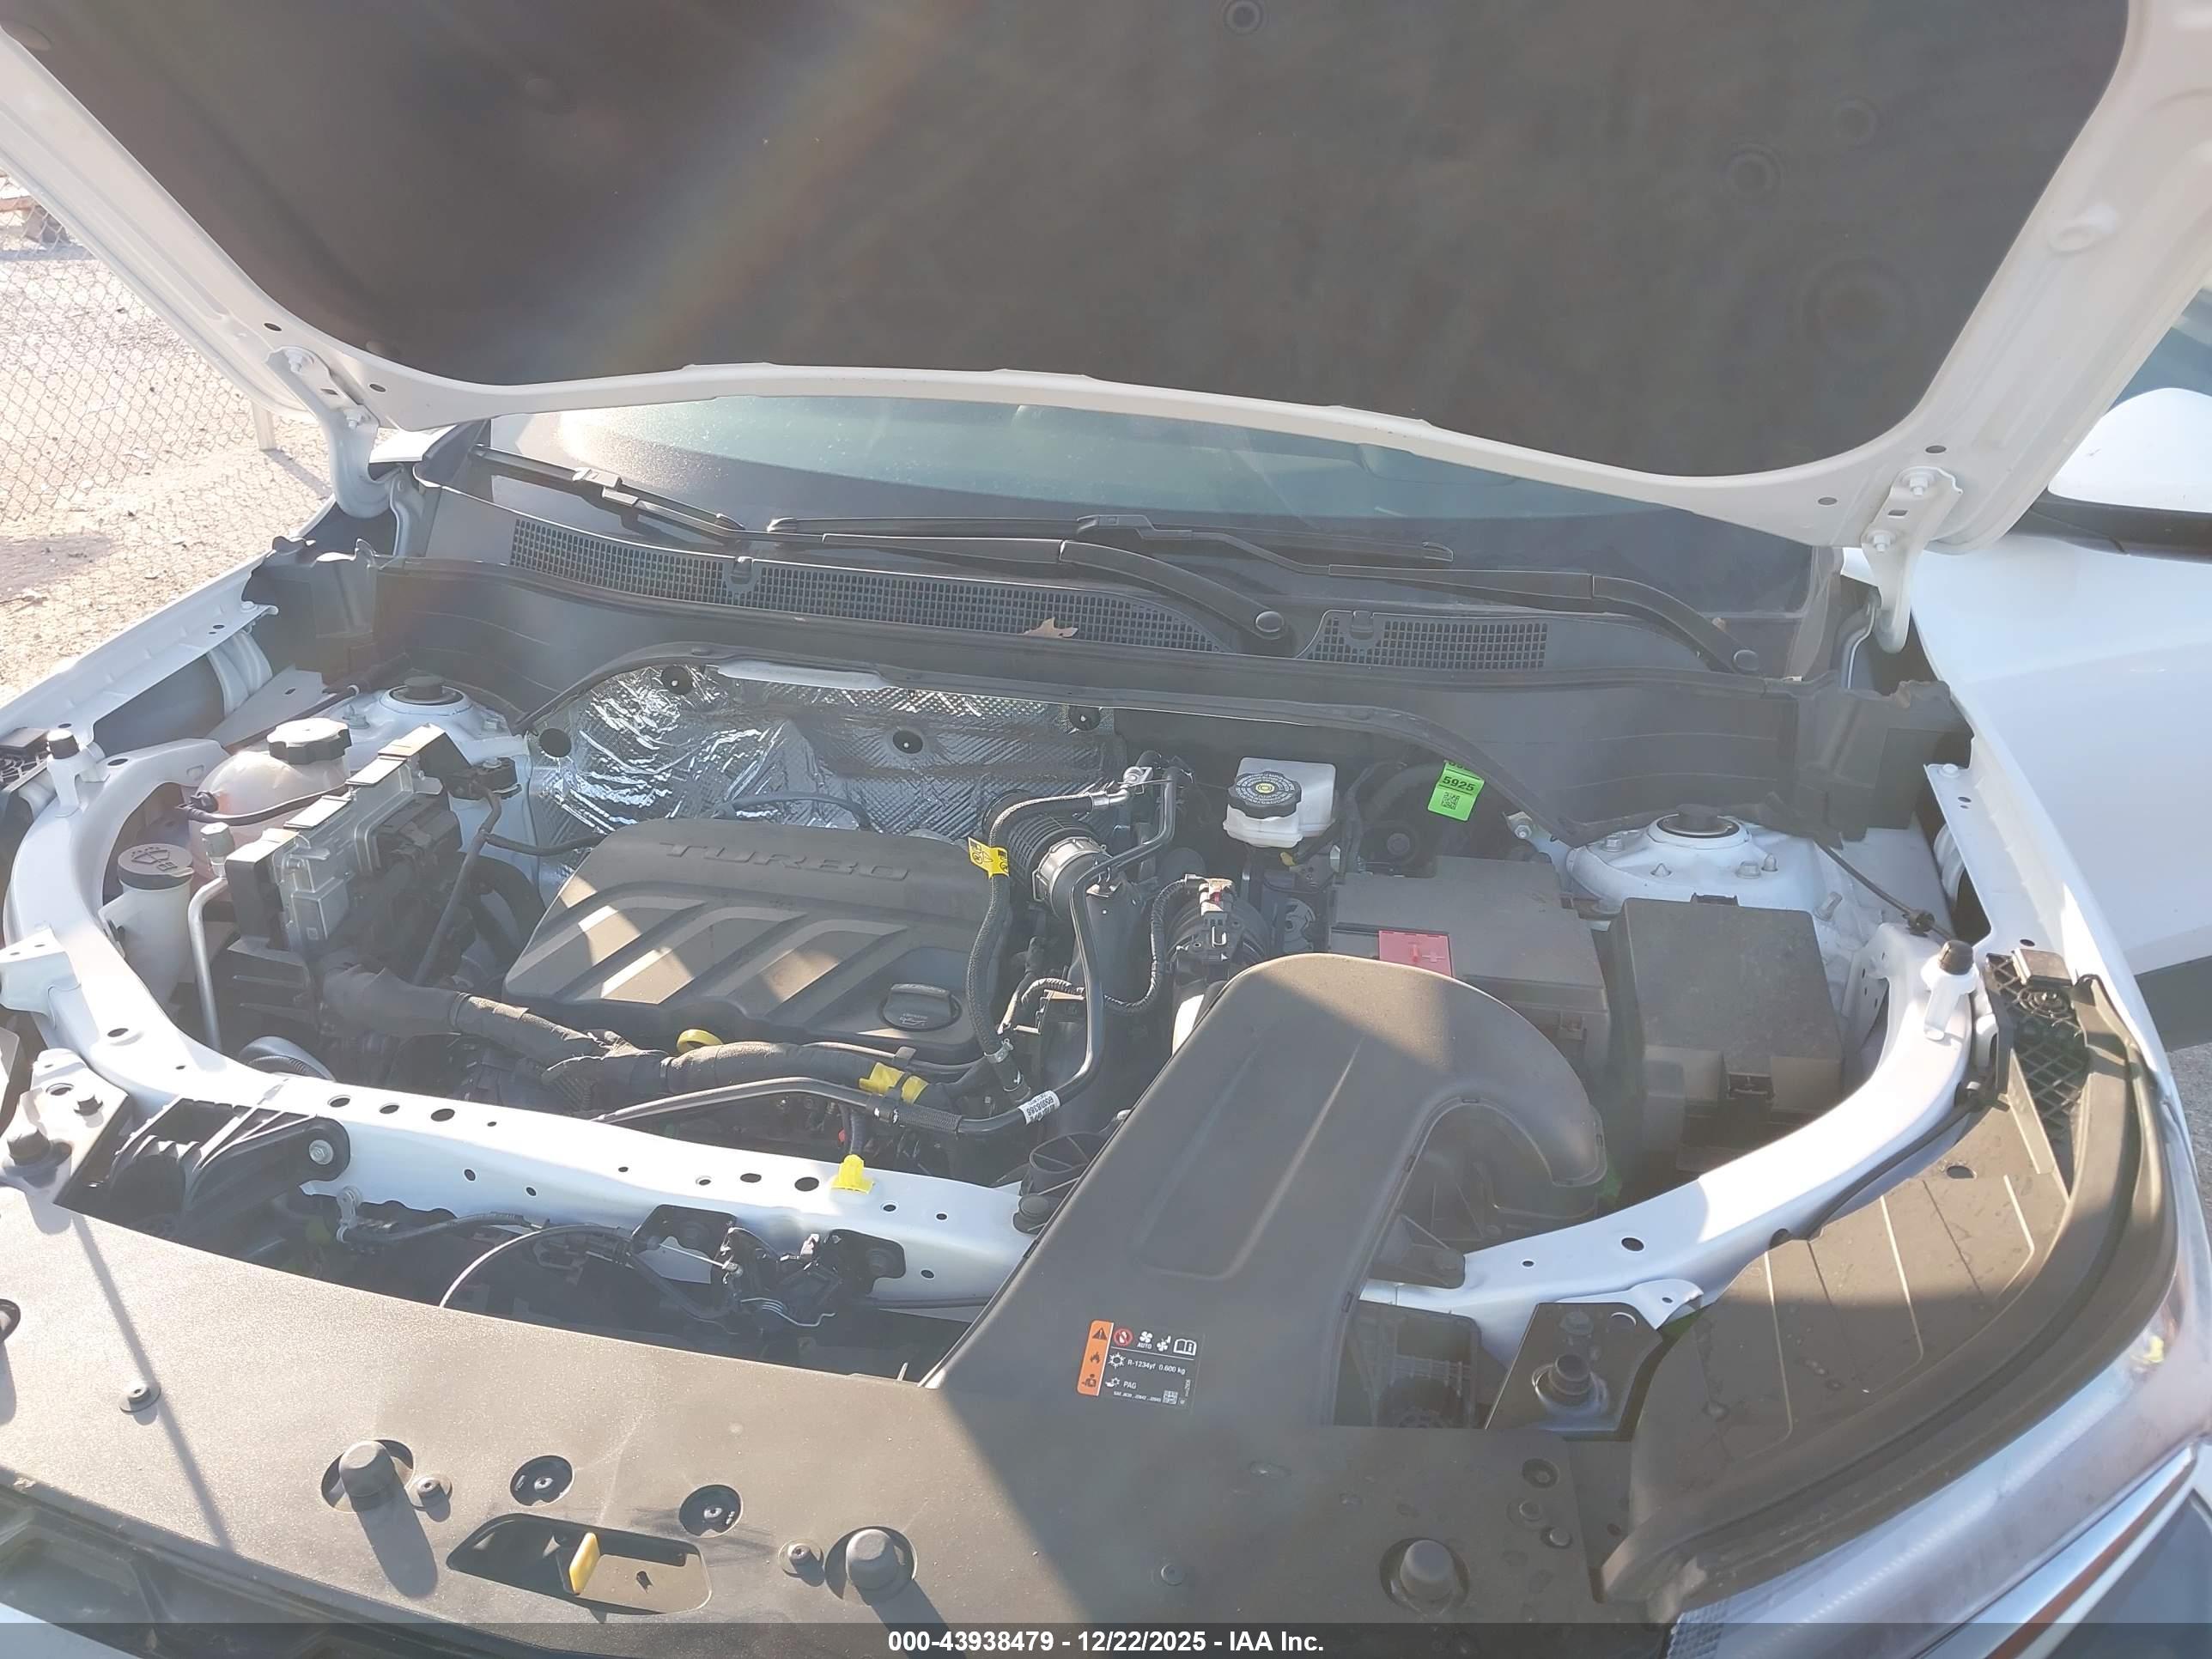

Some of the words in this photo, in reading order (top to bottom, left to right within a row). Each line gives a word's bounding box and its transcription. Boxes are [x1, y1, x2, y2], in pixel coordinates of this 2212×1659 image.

[1442, 775, 1476, 792] 5925
[659, 842, 909, 881] TURBO
[1127, 1359, 1156, 1370] R-1234yf
[1177, 1366, 1186, 1376] kg
[1123, 1381, 1137, 1389] PAG
